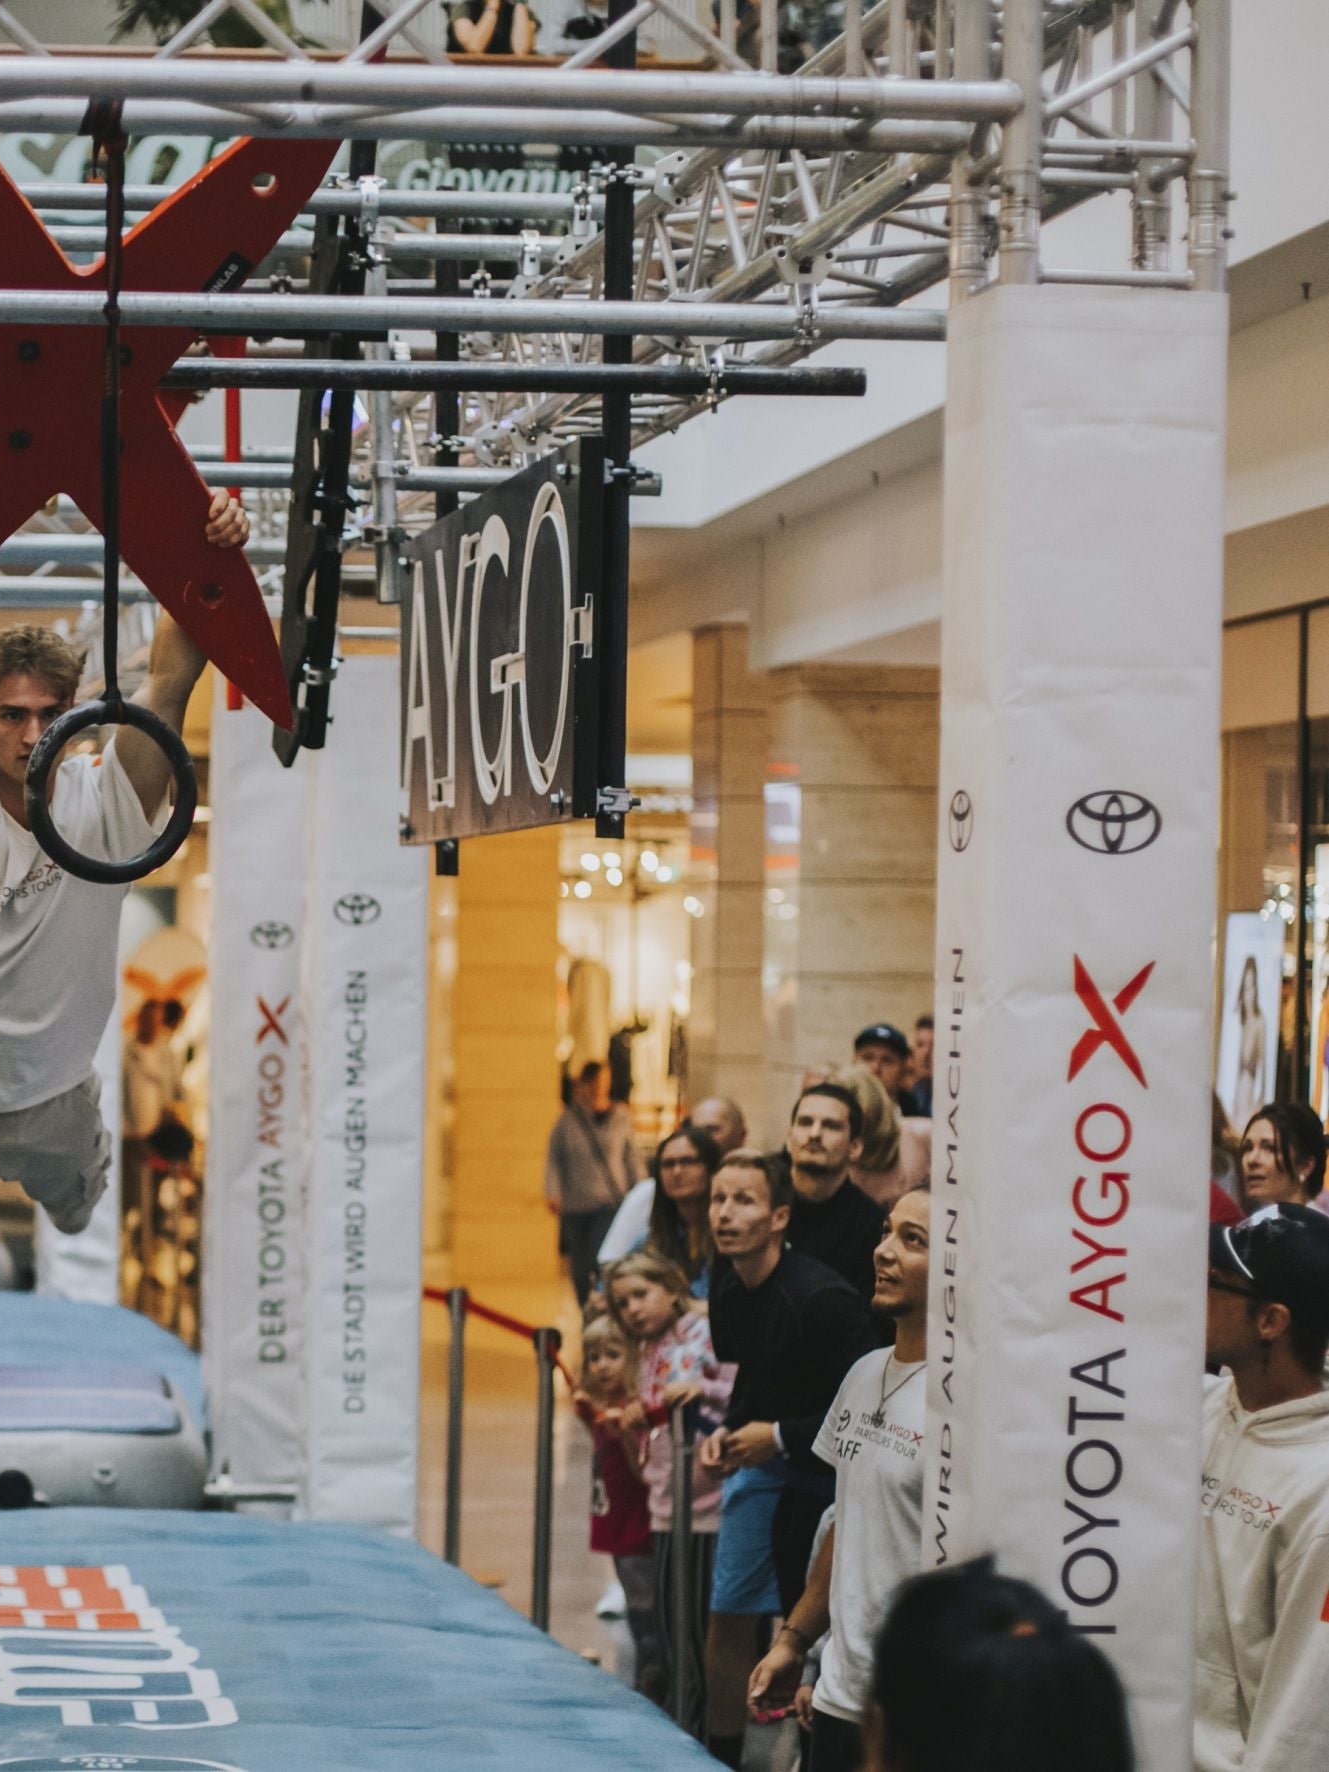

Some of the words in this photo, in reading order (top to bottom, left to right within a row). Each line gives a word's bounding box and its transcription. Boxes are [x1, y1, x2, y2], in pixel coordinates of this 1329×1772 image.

[400, 481, 572, 813] AYGO
[344, 969, 369, 1087] MACHEN
[945, 948, 965, 1186] MACHEN
[257, 1054, 285, 1149] AYGO
[344, 1096, 368, 1192] AUGEN
[257, 1157, 286, 1289] TOYOTA
[343, 1200, 368, 1276] WIRD
[1069, 1102, 1132, 1324] AYGO
[258, 1297, 287, 1363] DER
[342, 1282, 367, 1363] STADT
[941, 1208, 959, 1405] AUGEN
[343, 1370, 367, 1415] DIE
[887, 1423, 911, 1440] AYGO
[892, 1439, 917, 1460] TOUR
[935, 1422, 953, 1567] WIRD
